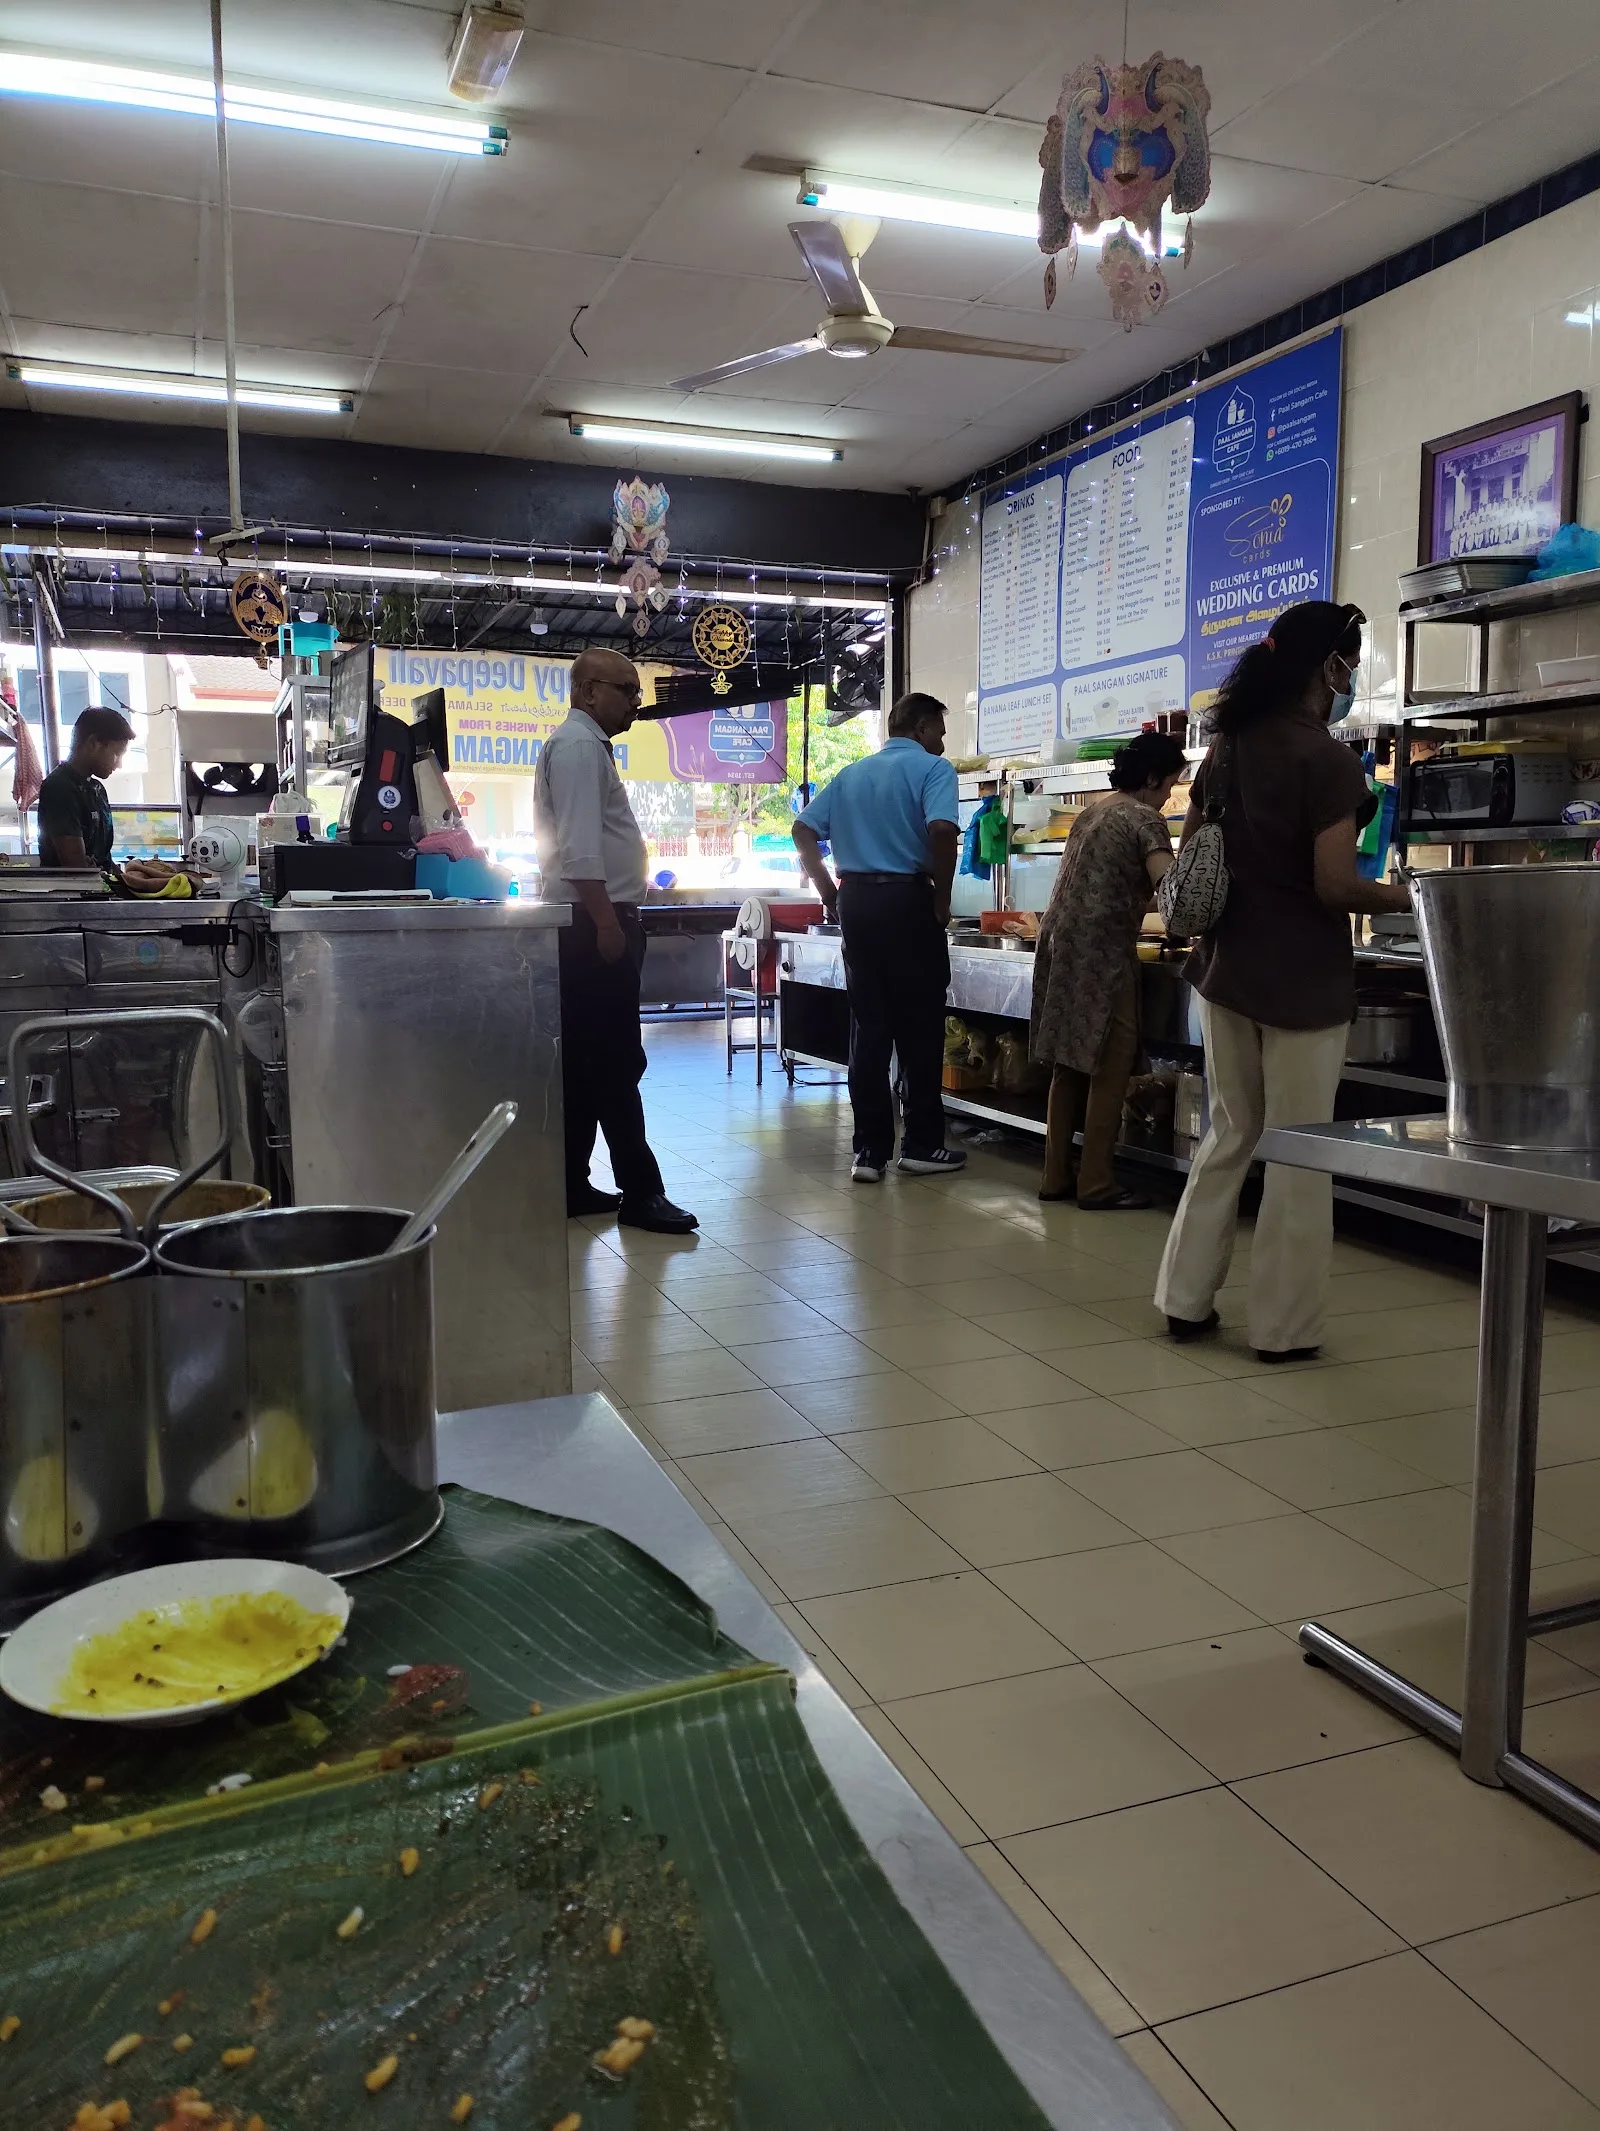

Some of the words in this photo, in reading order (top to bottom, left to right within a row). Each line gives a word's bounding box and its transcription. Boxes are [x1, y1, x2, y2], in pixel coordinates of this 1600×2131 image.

[1278, 404, 1290, 414] Paal
[1291, 396, 1314, 410] Sangam
[1315, 389, 1328, 399] Cafe
[1277, 413, 1316, 434] @paalsangam
[1218, 435, 1231, 446] PAAL
[1232, 426, 1252, 440] SANGAM
[1112, 446, 1141, 469] FOOD
[1227, 443, 1240, 453] CAFE
[1006, 493, 1035, 515] DRINKS
[1201, 498, 1236, 516] SPONSORED
[1236, 495, 1242, 505] BY
[1224, 506, 1284, 557] Sonia
[1243, 550, 1271, 564] cards
[1210, 572, 1251, 592] EXCLUSIVE
[1253, 570, 1260, 581] &
[1261, 557, 1304, 579] PREMIUM
[1196, 583, 1263, 616] WEDDING
[1267, 569, 1319, 599] CARDS
[1213, 639, 1225, 648] VISIT
[1225, 637, 1237, 647] OUR
[1238, 631, 1261, 644] NEAREST
[1261, 630, 1269, 639] SH
[1074, 684, 1090, 696] PAAL
[1093, 676, 1125, 692] SANGAM
[1127, 667, 1168, 685] SIGNATURE
[984, 704, 1006, 716] BANANA
[1008, 700, 1020, 711] LEAF
[1022, 696, 1041, 708] LUNCH
[1043, 693, 1051, 704] SET
